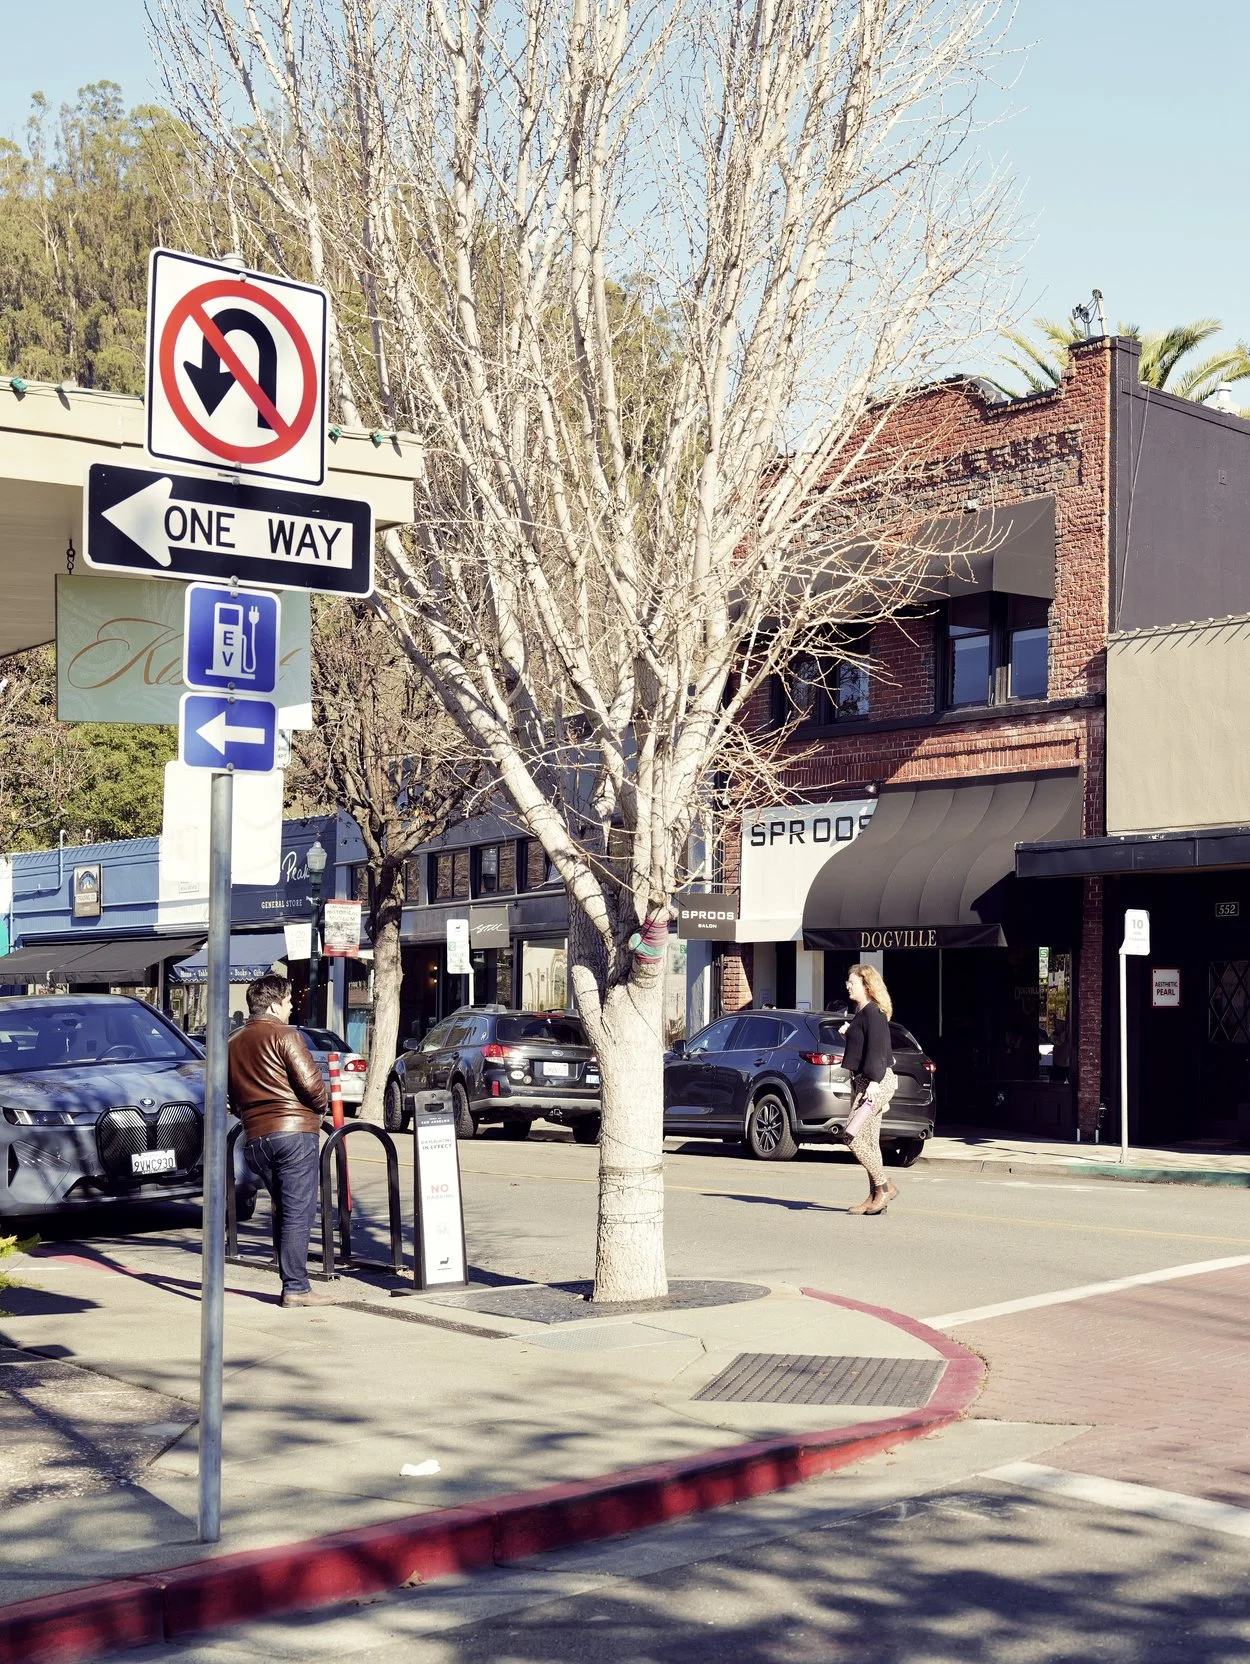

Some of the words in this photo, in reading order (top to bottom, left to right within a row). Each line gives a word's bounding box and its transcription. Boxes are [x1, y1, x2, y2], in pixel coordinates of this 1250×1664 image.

[164, 506, 236, 548] ONE
[268, 518, 342, 561] WAY
[261, 900, 285, 909] GENERAL
[286, 899, 303, 908] STORE
[1218, 904, 1236, 915] 552
[681, 910, 735, 921] SPROOS
[1132, 919, 1144, 929] 10
[860, 930, 937, 948] DOGVILLE
[431, 1183, 449, 1193] NO
[426, 1193, 455, 1201] PARKING
